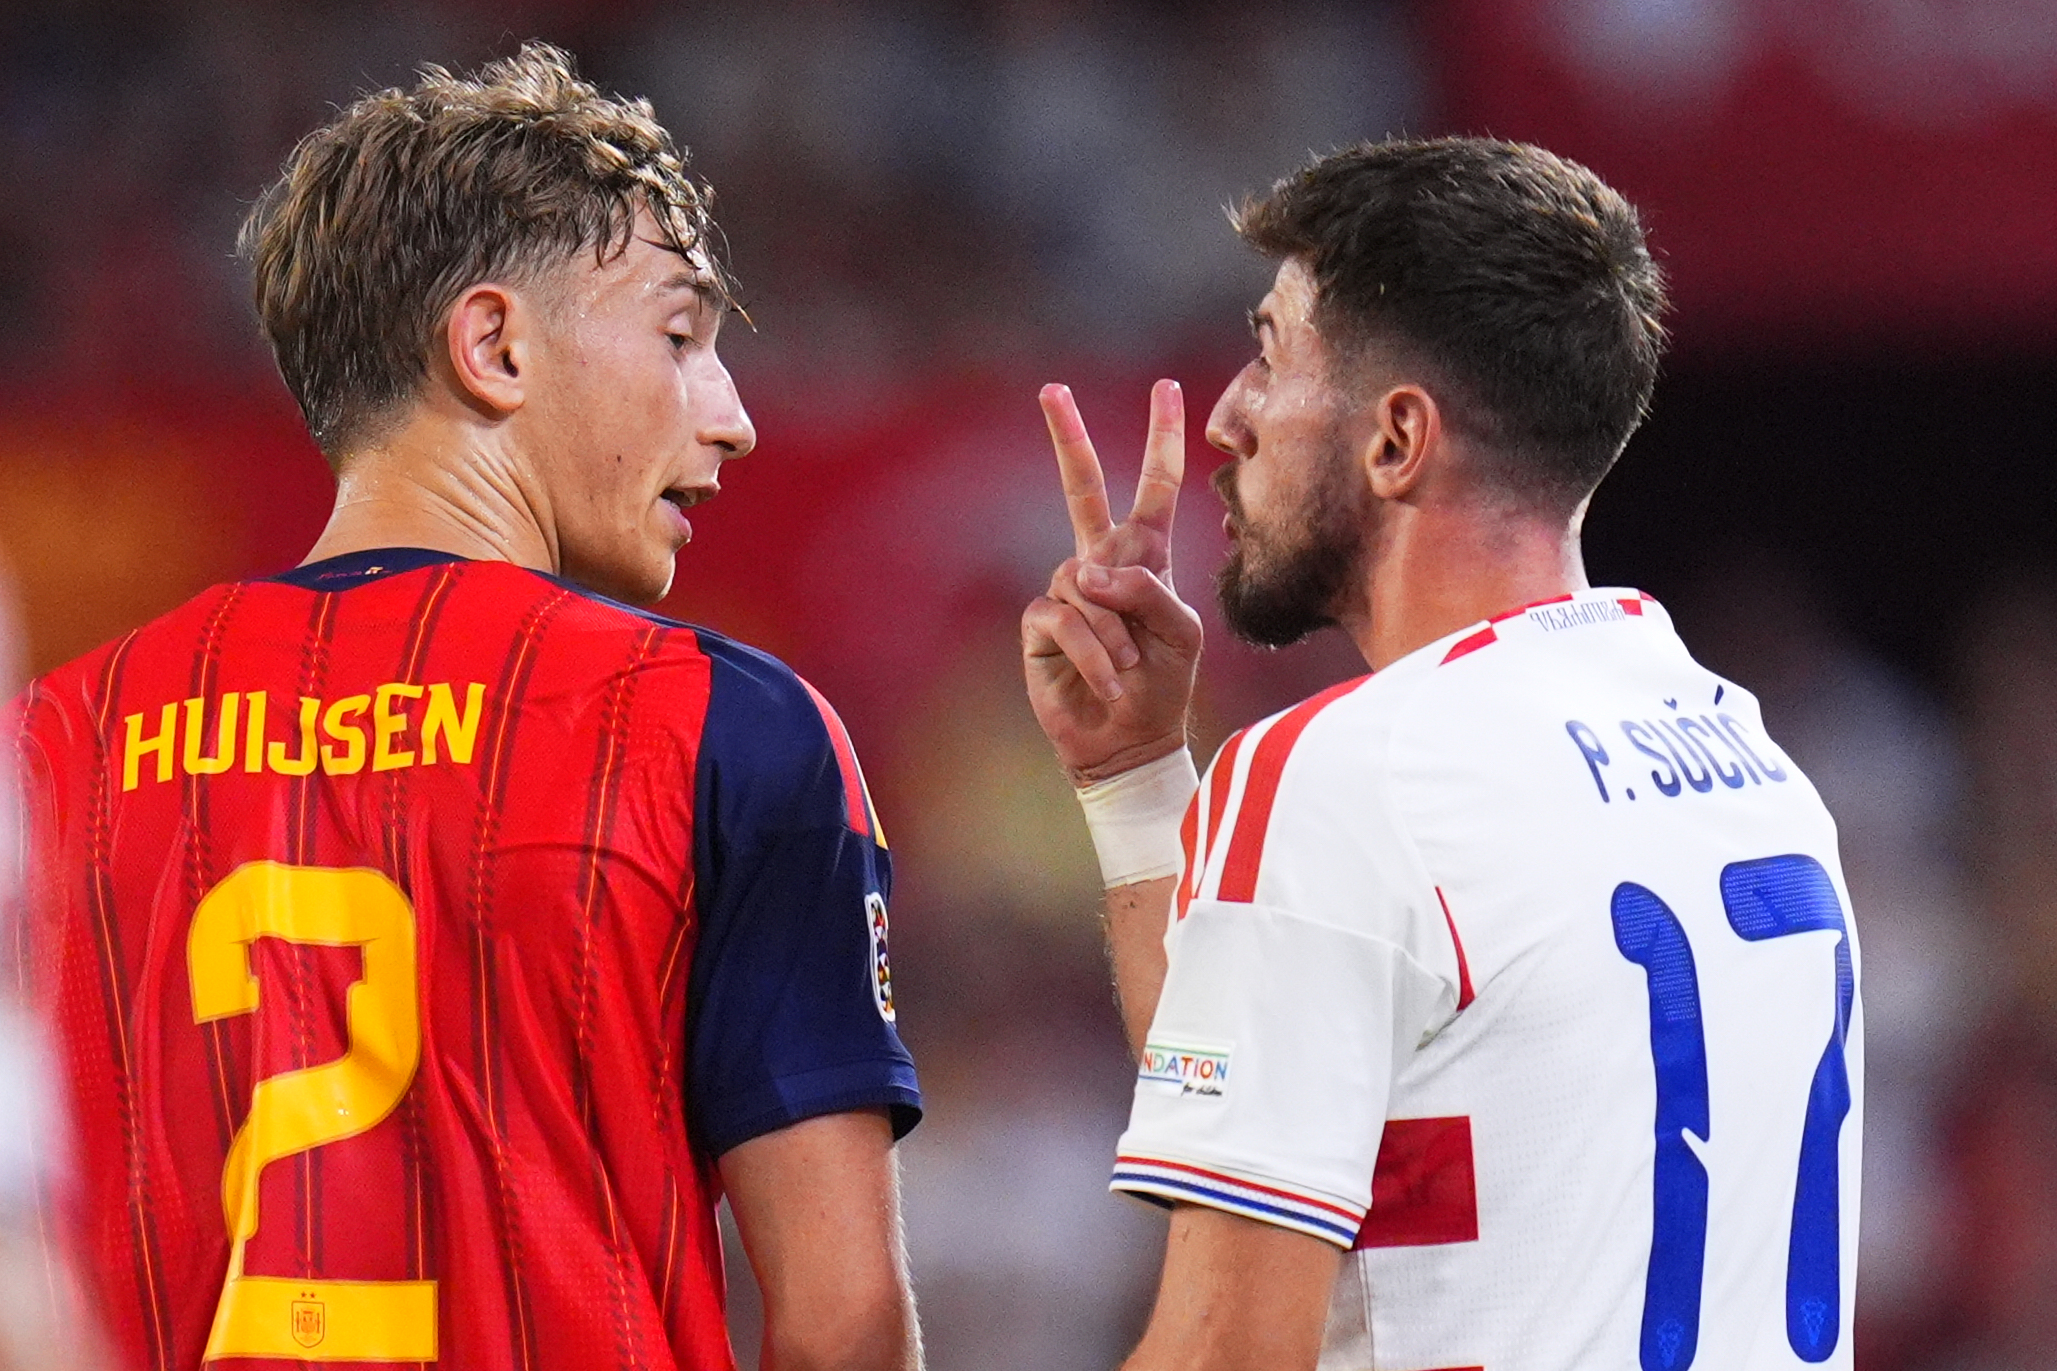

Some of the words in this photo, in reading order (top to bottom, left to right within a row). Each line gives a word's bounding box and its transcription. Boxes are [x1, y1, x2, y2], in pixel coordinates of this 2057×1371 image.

[122, 682, 487, 793] HUIJSEN
[1565, 719, 1636, 803] P.
[186, 859, 439, 1362] 2
[1610, 853, 1855, 1371] 17
